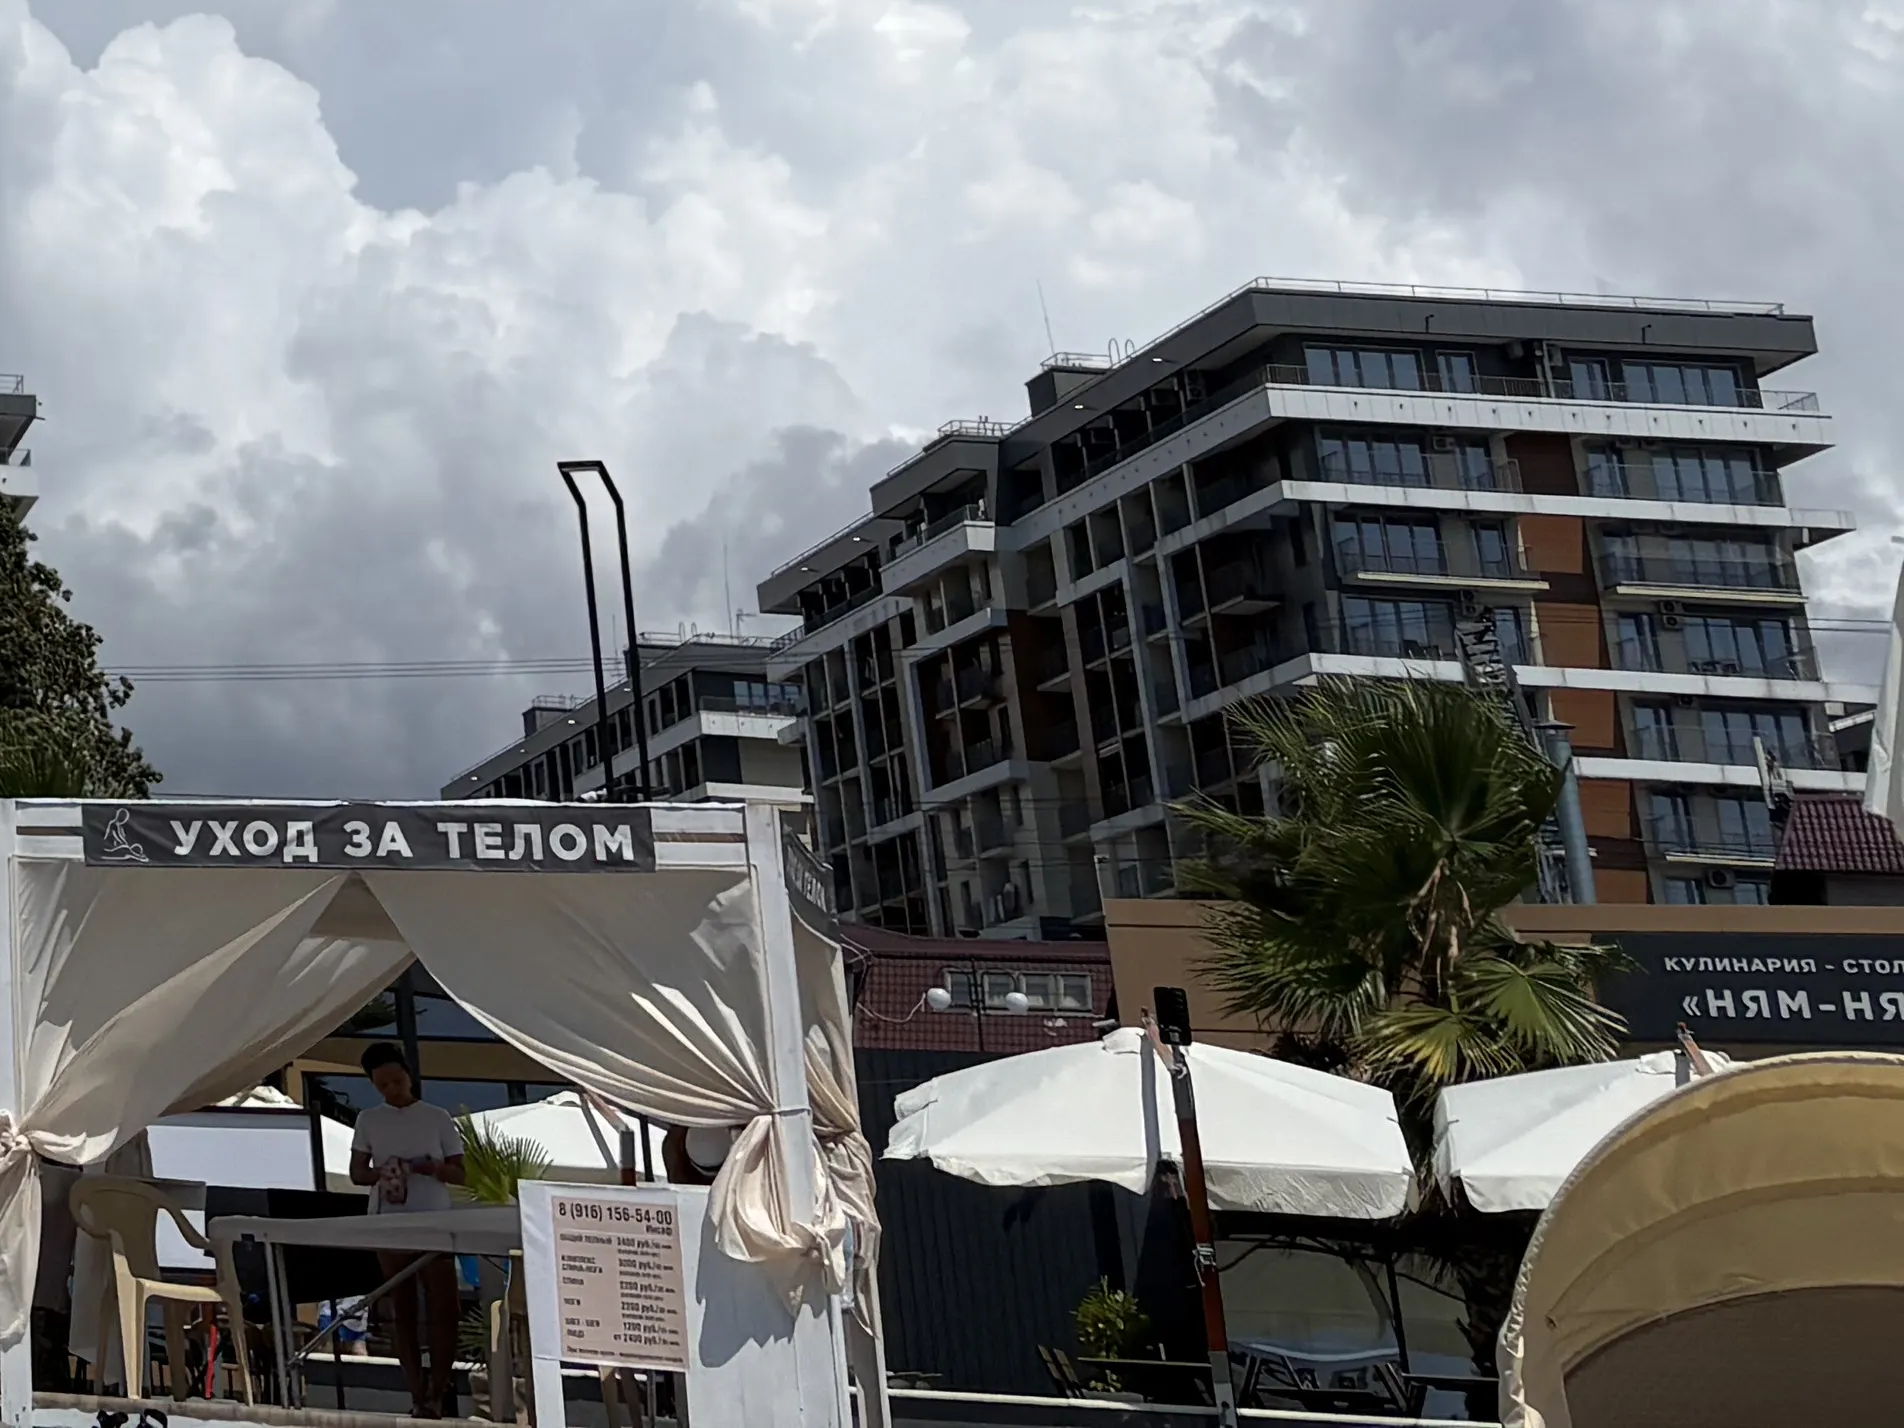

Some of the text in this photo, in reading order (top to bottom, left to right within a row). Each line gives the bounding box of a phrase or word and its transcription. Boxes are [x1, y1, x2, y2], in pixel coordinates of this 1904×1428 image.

[170, 820, 635, 863] УХОД ЗА ТЕЛОМ
[1664, 957, 1817, 973] КУЛИНАРИЯ
[559, 1202, 673, 1225] 8 (916) 156-54-00
